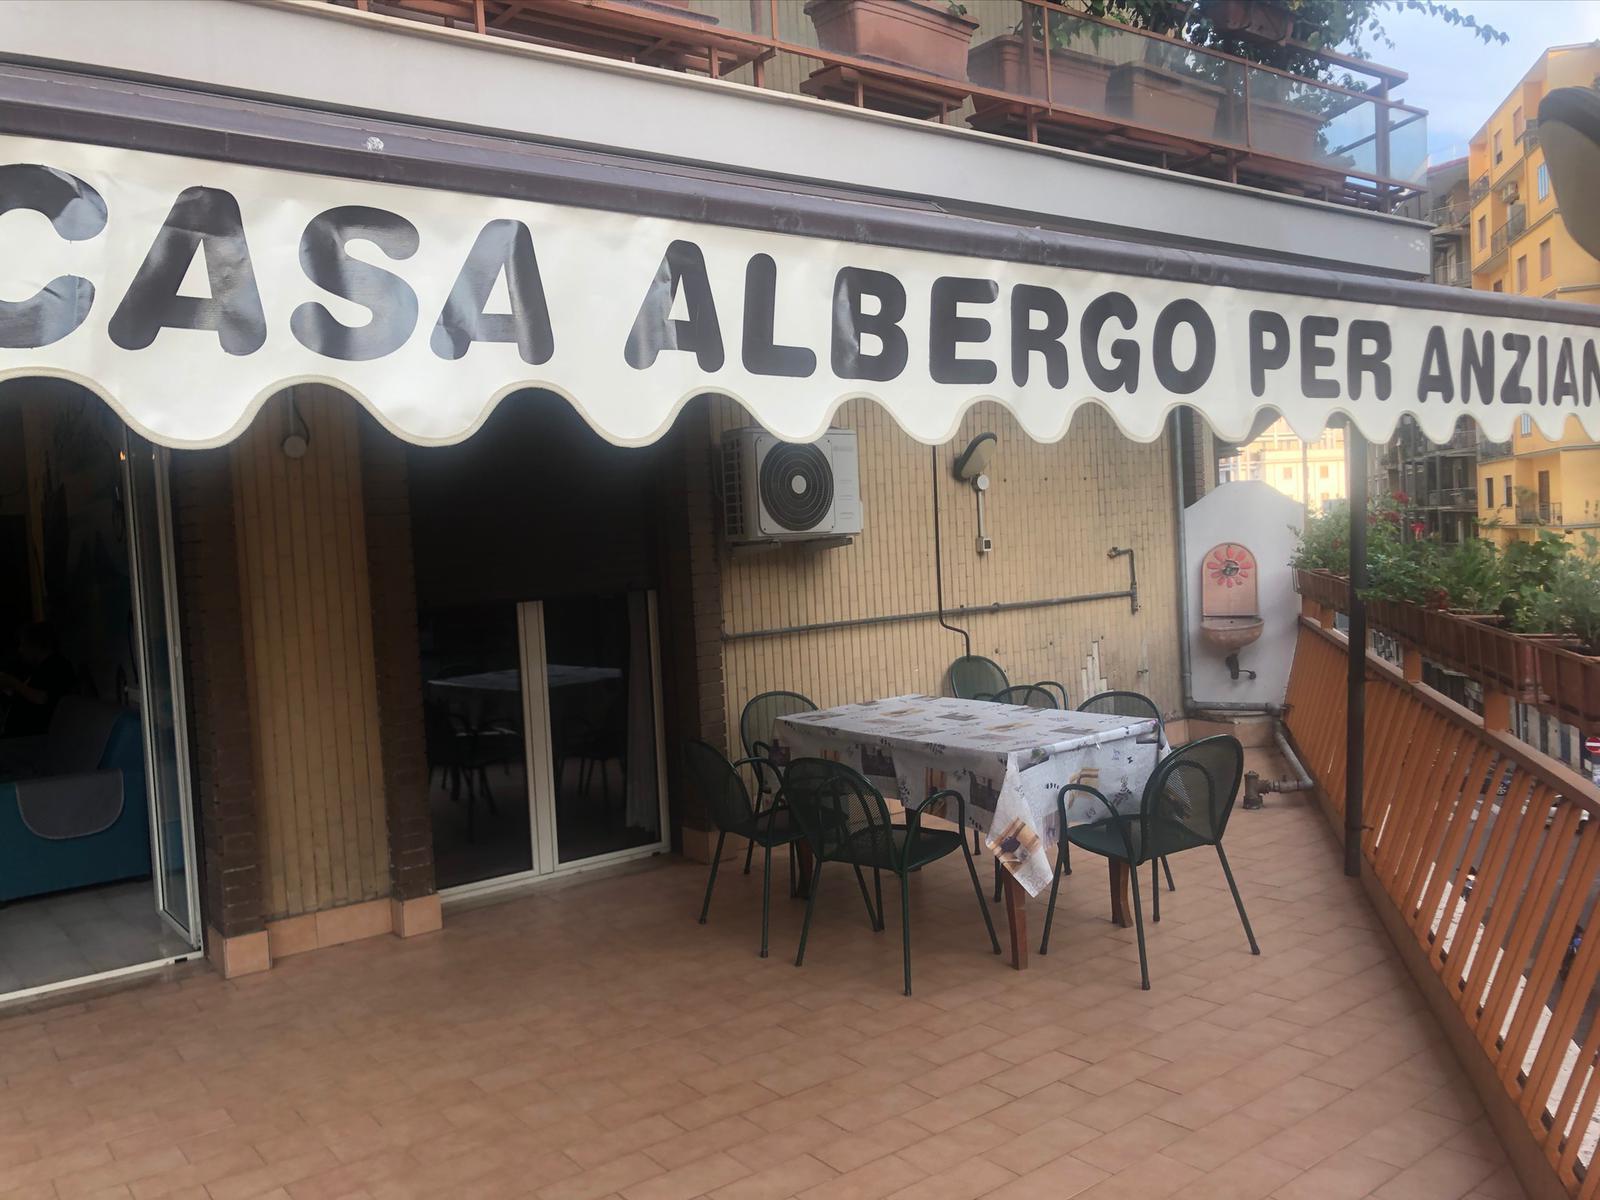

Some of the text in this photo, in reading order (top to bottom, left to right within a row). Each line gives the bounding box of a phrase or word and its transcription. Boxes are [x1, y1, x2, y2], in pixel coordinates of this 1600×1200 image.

[0, 163, 555, 365] CASA
[624, 239, 1216, 395] ALBERGO
[1249, 309, 1392, 401] PER
